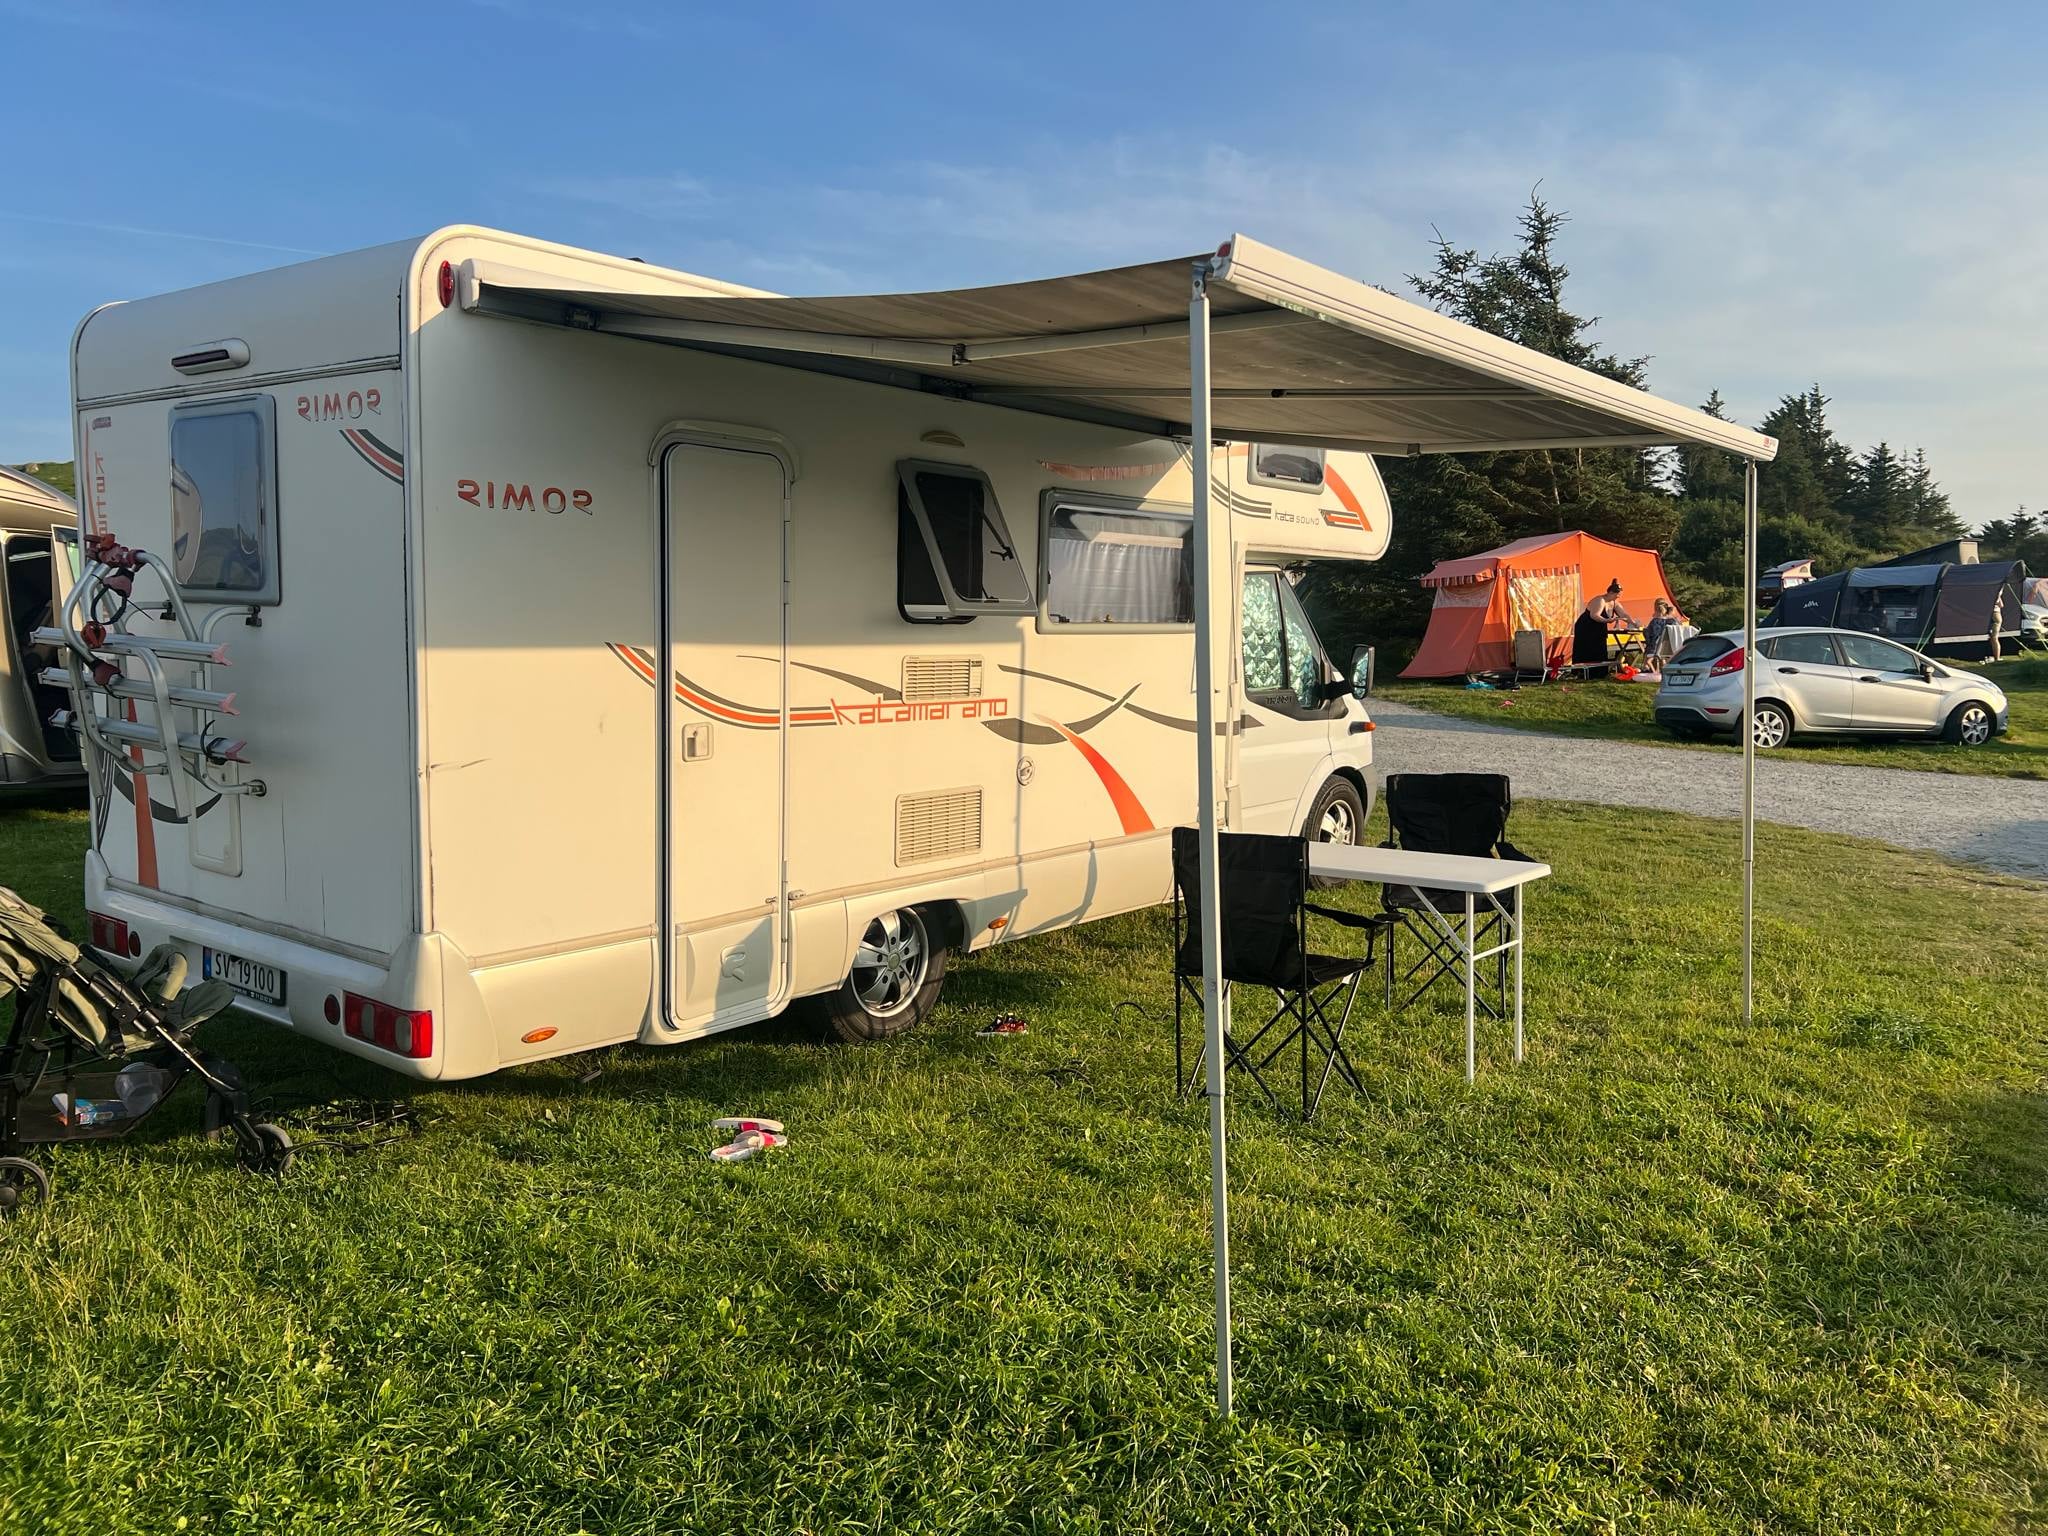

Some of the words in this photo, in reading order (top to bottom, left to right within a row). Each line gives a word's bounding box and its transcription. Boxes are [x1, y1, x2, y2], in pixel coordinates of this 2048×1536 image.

[297, 388, 382, 422] RIMOR
[457, 479, 593, 516] RIMOR
[1296, 515, 1320, 526] SOUND
[215, 953, 231, 979] SV
[238, 959, 274, 994] 19100
